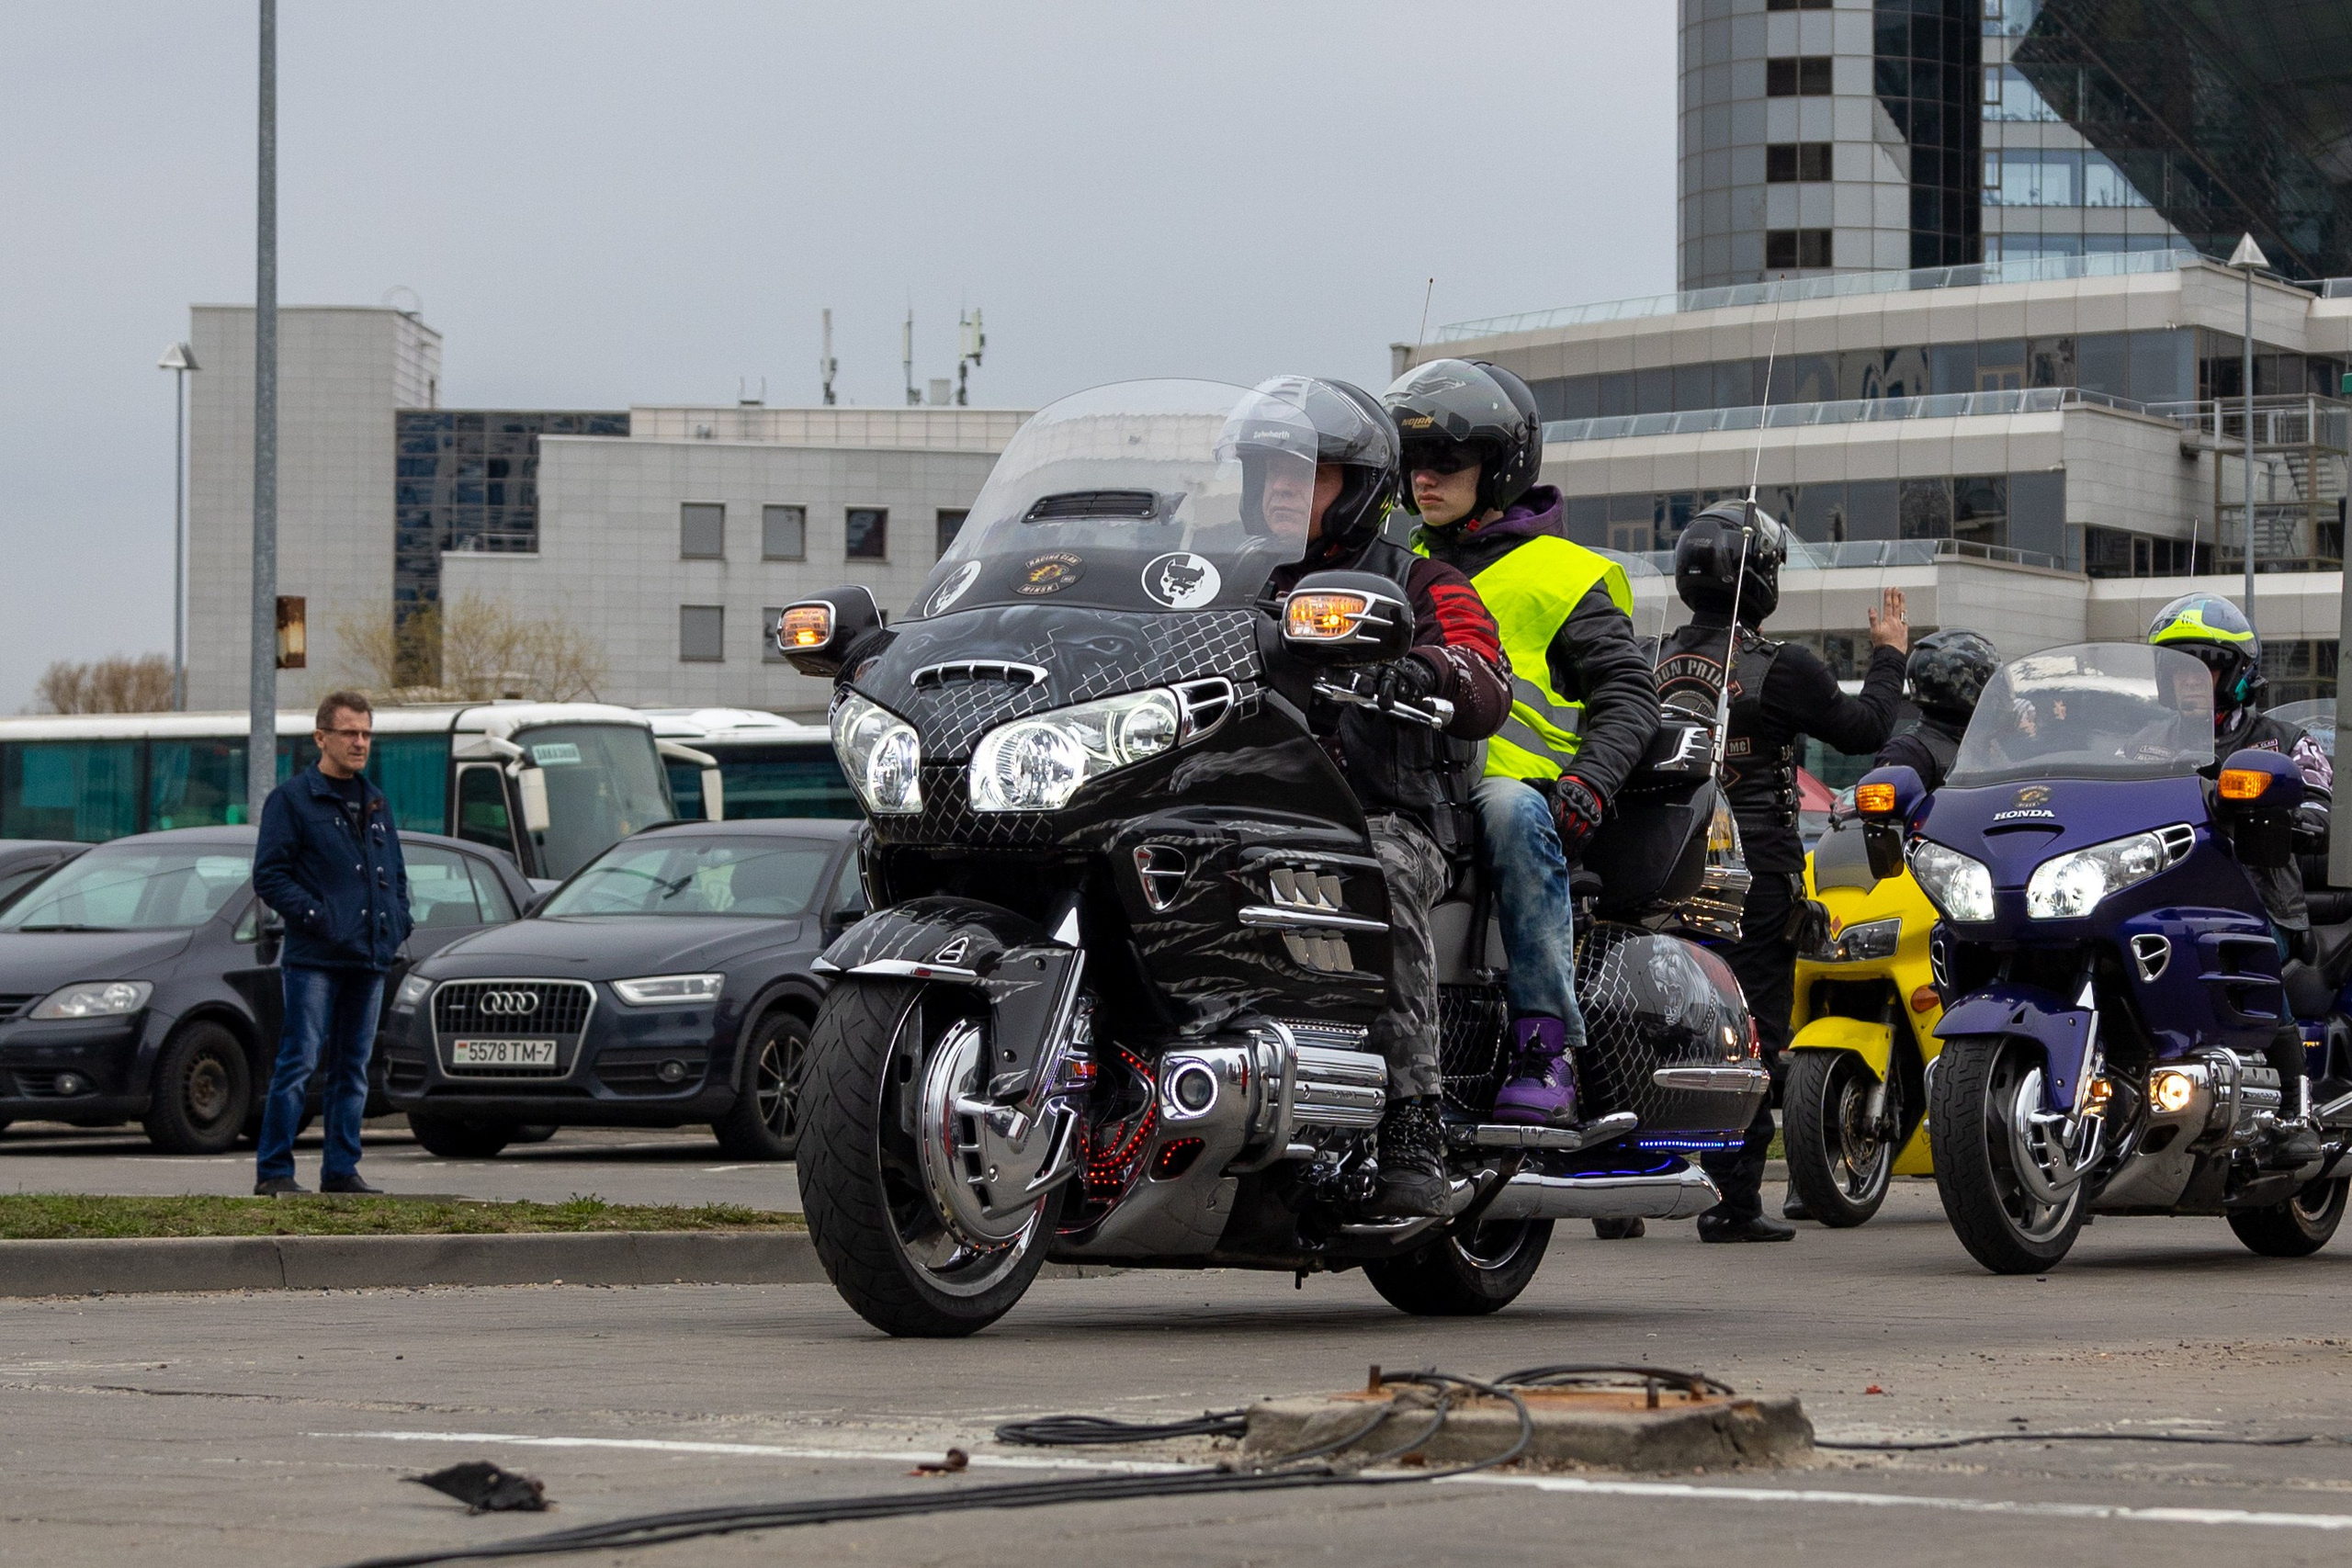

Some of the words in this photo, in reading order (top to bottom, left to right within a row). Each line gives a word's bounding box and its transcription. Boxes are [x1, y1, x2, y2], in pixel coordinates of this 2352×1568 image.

[1401, 416, 1434, 429] NOLAN
[1021, 584, 1054, 593] MINSK
[1654, 660, 1682, 688] RON
[1687, 659, 1724, 688] PRID
[1728, 741, 1747, 752] MC
[1993, 809, 2055, 821] HONDA
[469, 1042, 508, 1062] 5578
[510, 1042, 553, 1062] TM-7
